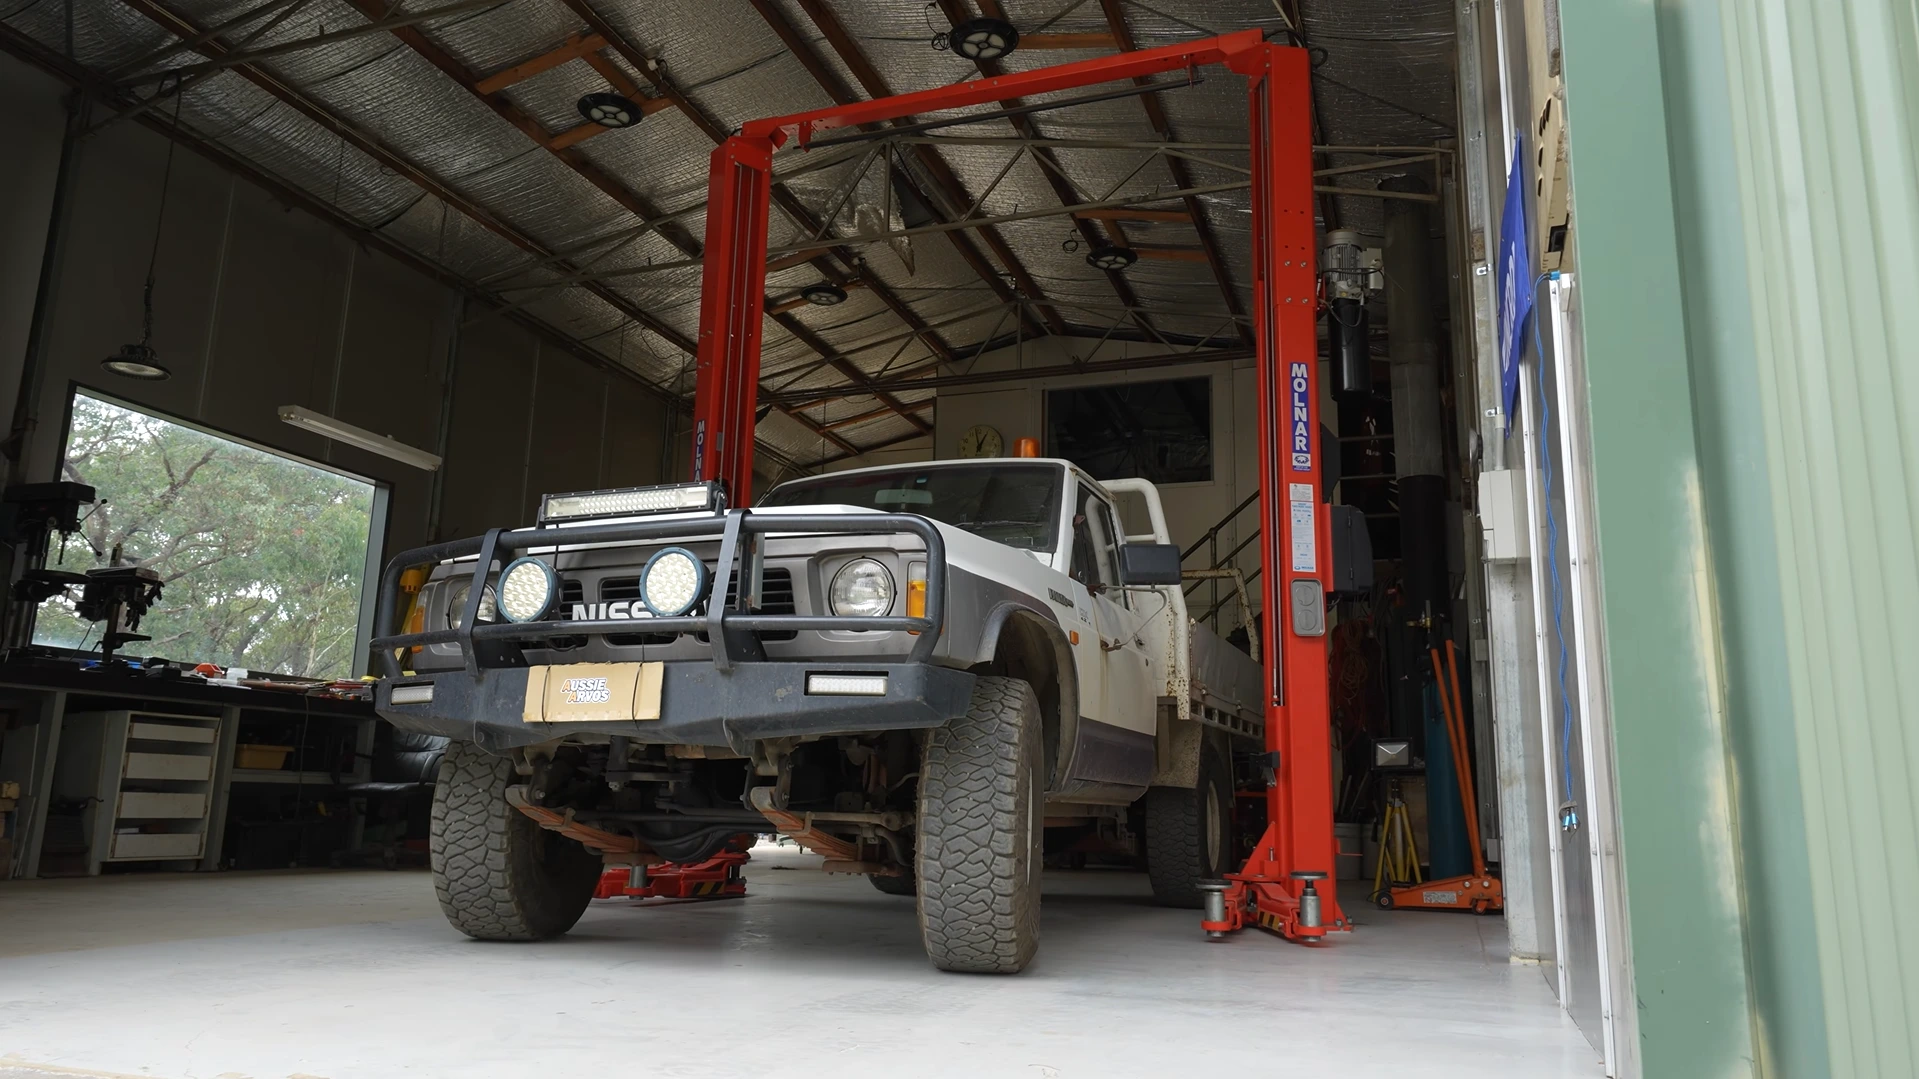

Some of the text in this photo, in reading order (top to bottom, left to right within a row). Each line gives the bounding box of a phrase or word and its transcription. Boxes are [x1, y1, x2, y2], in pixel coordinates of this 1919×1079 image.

[1291, 363, 1308, 451] MOLNAR
[694, 420, 705, 482] MOLNA
[562, 678, 607, 692] AUSSIE
[568, 690, 610, 703] ARVOS
